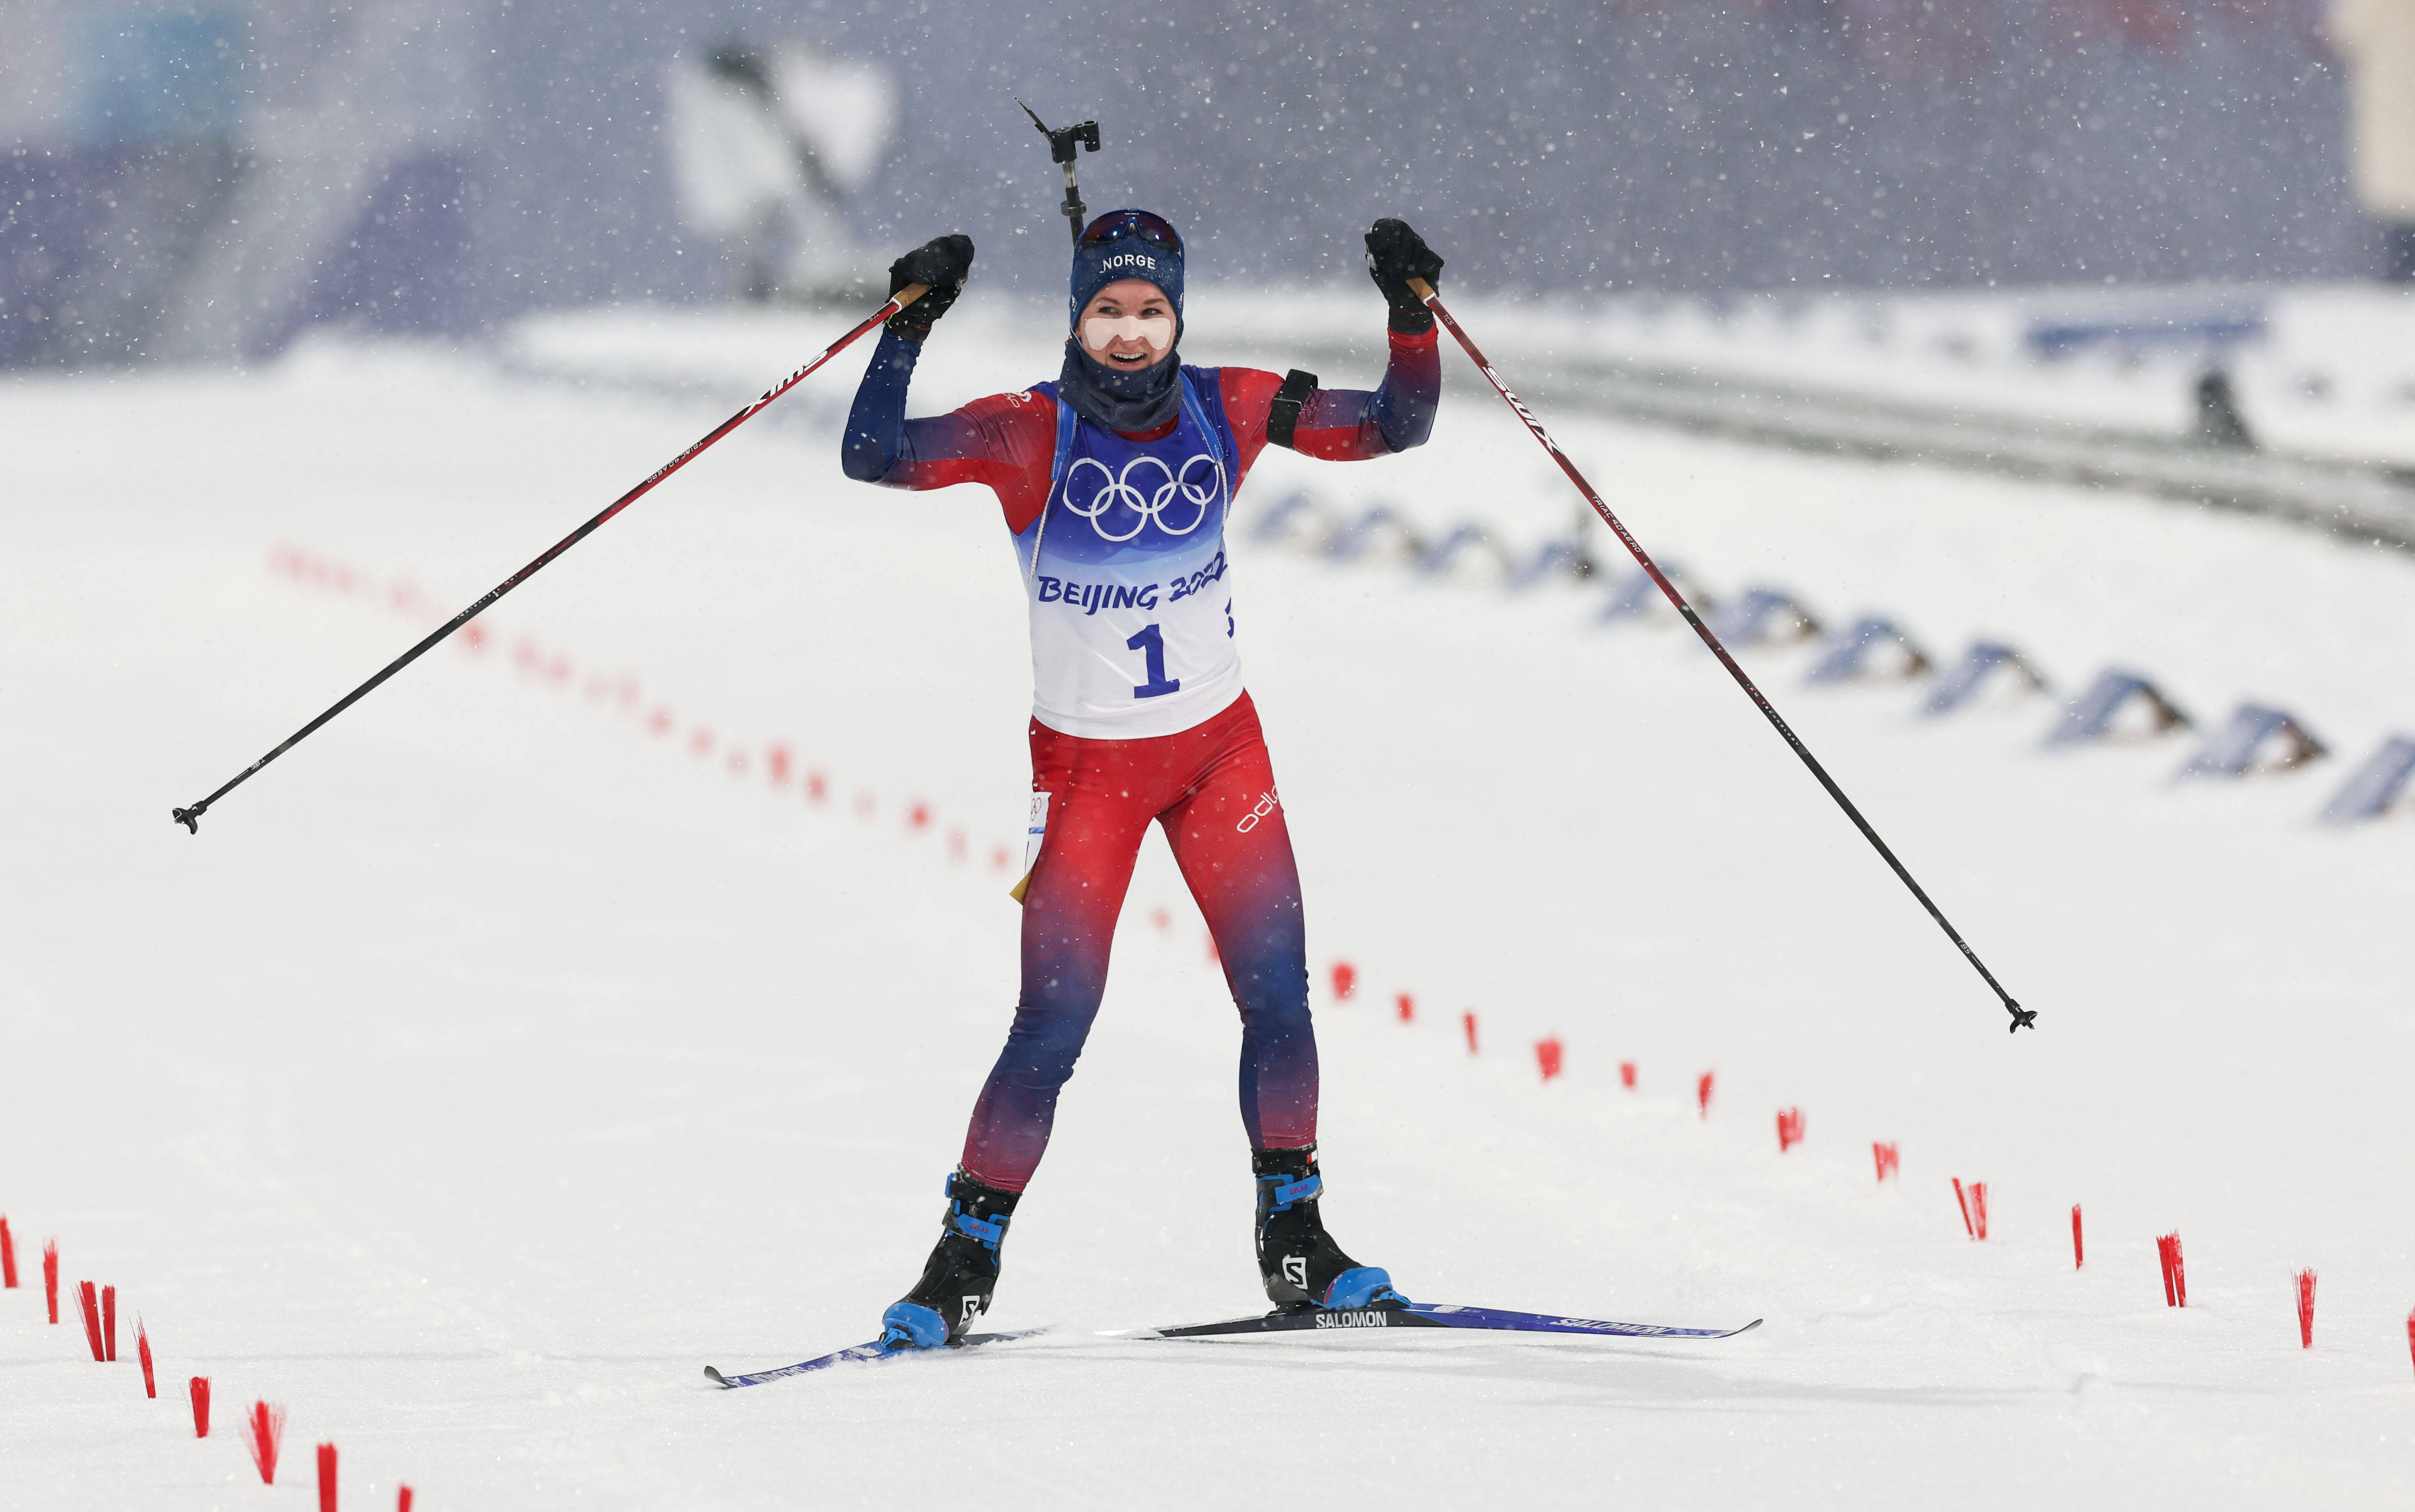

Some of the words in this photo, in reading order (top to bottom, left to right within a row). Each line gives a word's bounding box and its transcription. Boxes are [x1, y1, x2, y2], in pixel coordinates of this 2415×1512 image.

[1100, 254, 1156, 274] NORGE
[1443, 314, 1454, 325] TCS
[680, 441, 704, 460] TRIAC
[647, 465, 668, 483] AERO
[1593, 495, 1613, 519] TRIAC
[1620, 531, 1642, 553] AERO
[1038, 576, 1158, 615] BEIJING
[1168, 551, 1228, 603] 2022
[1126, 623, 1180, 699] 1
[1958, 939, 1972, 954] TBS
[1285, 1261, 1305, 1285] S
[1315, 1311, 1387, 1328] SALOMON
[1549, 1318, 1675, 1334] SALOMON
